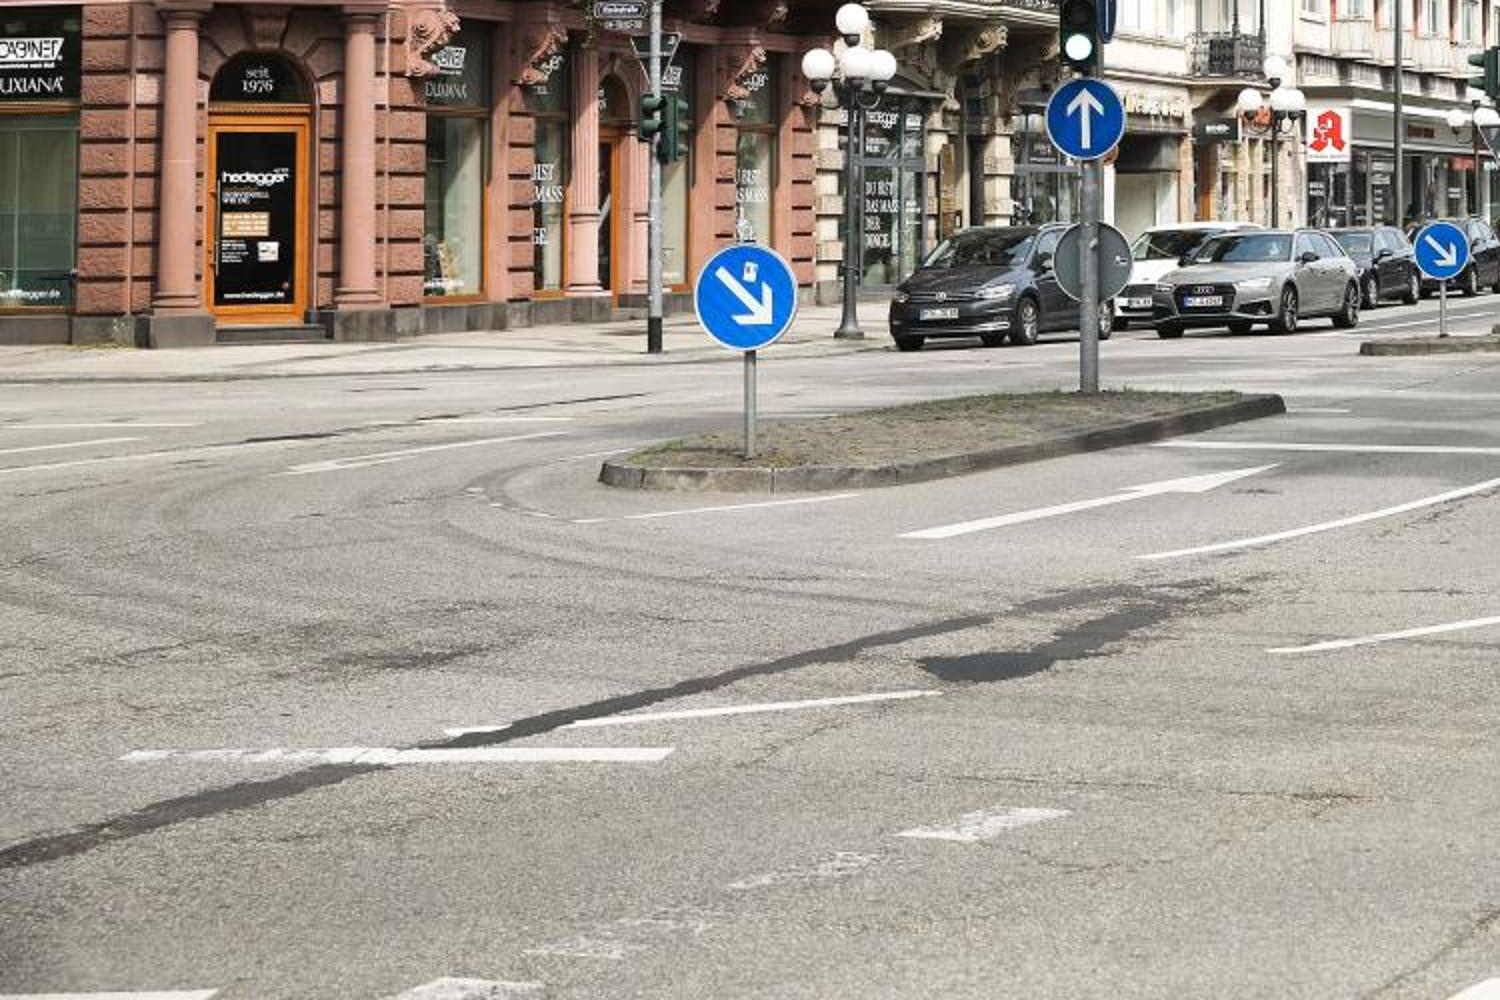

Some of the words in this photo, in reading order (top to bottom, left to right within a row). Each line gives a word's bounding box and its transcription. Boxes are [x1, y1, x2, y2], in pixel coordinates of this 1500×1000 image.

[245, 65, 270, 78] seit
[242, 79, 274, 93] 1976
[222, 171, 289, 187] hedegger
